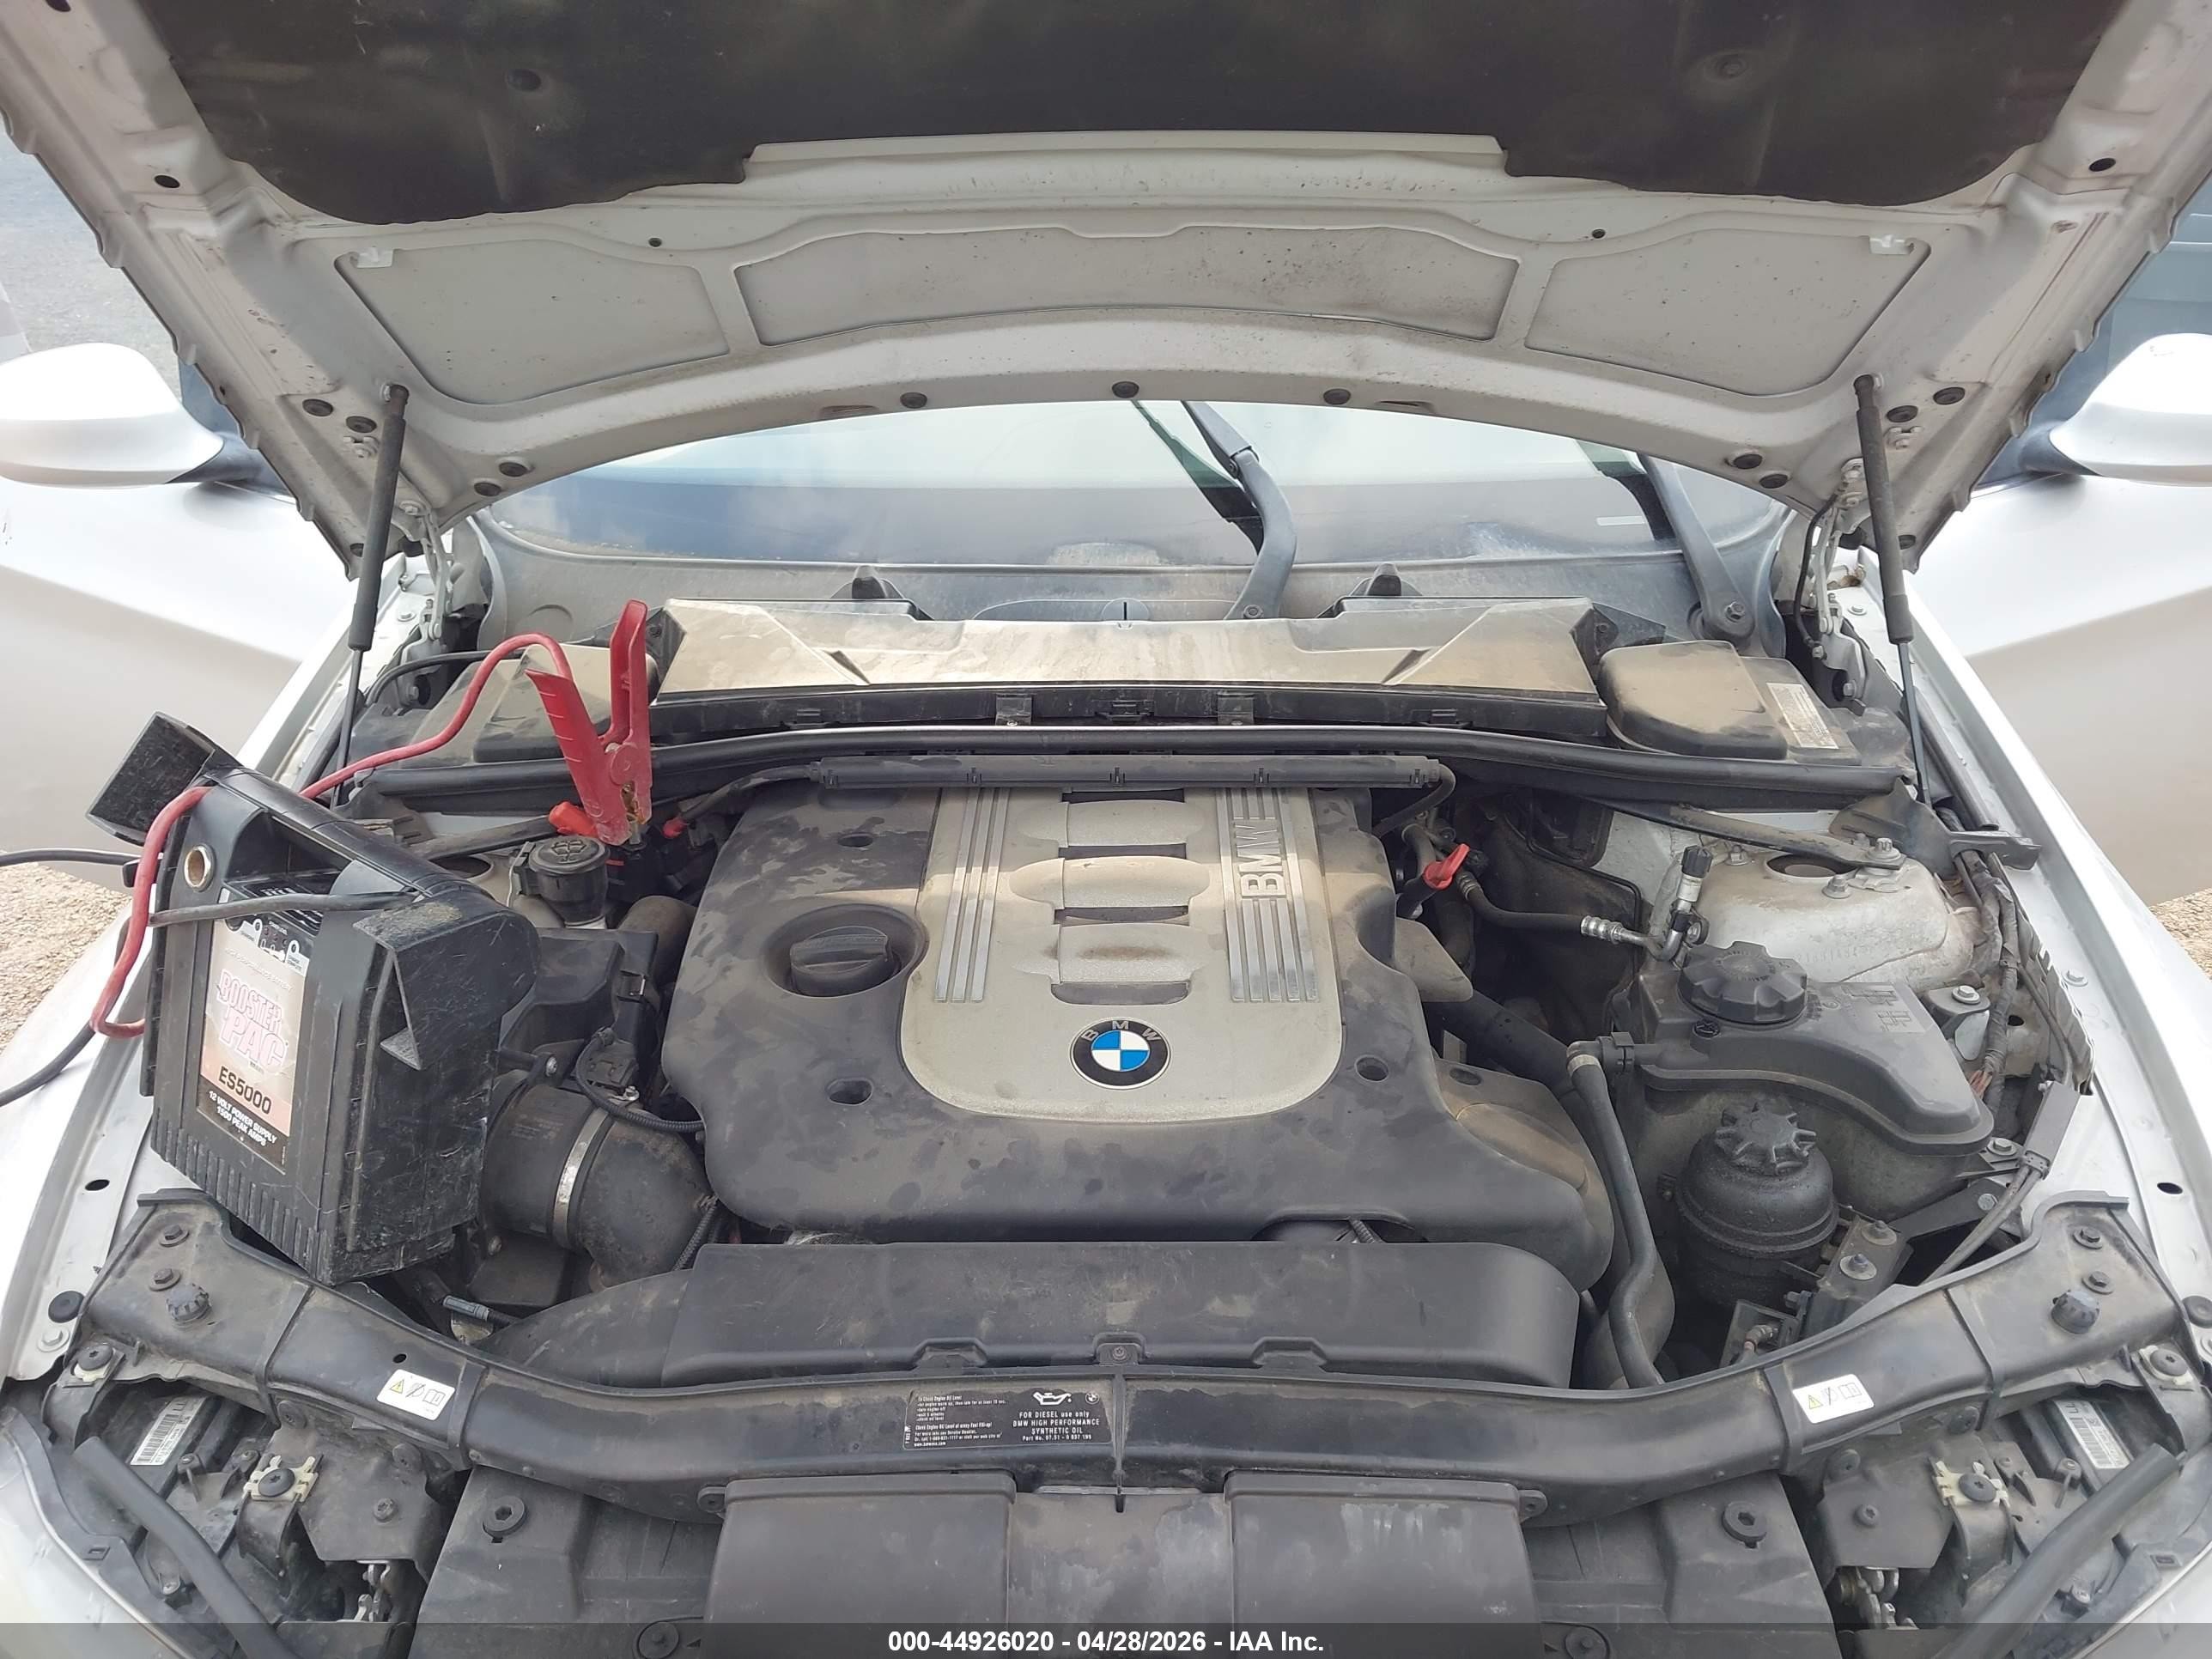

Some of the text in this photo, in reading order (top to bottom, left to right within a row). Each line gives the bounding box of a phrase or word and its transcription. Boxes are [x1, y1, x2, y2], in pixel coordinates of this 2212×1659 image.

[1233, 822, 1286, 897] BMW
[218, 969, 282, 1033] BOOSTER
[219, 1006, 287, 1072] PAC
[1081, 1020, 1162, 1042] BMW
[218, 1066, 272, 1115] ES5000
[209, 1091, 277, 1144] 12 VOLT POWER SUPPLY
[216, 1106, 266, 1146] 1500 PEAK AMPS
